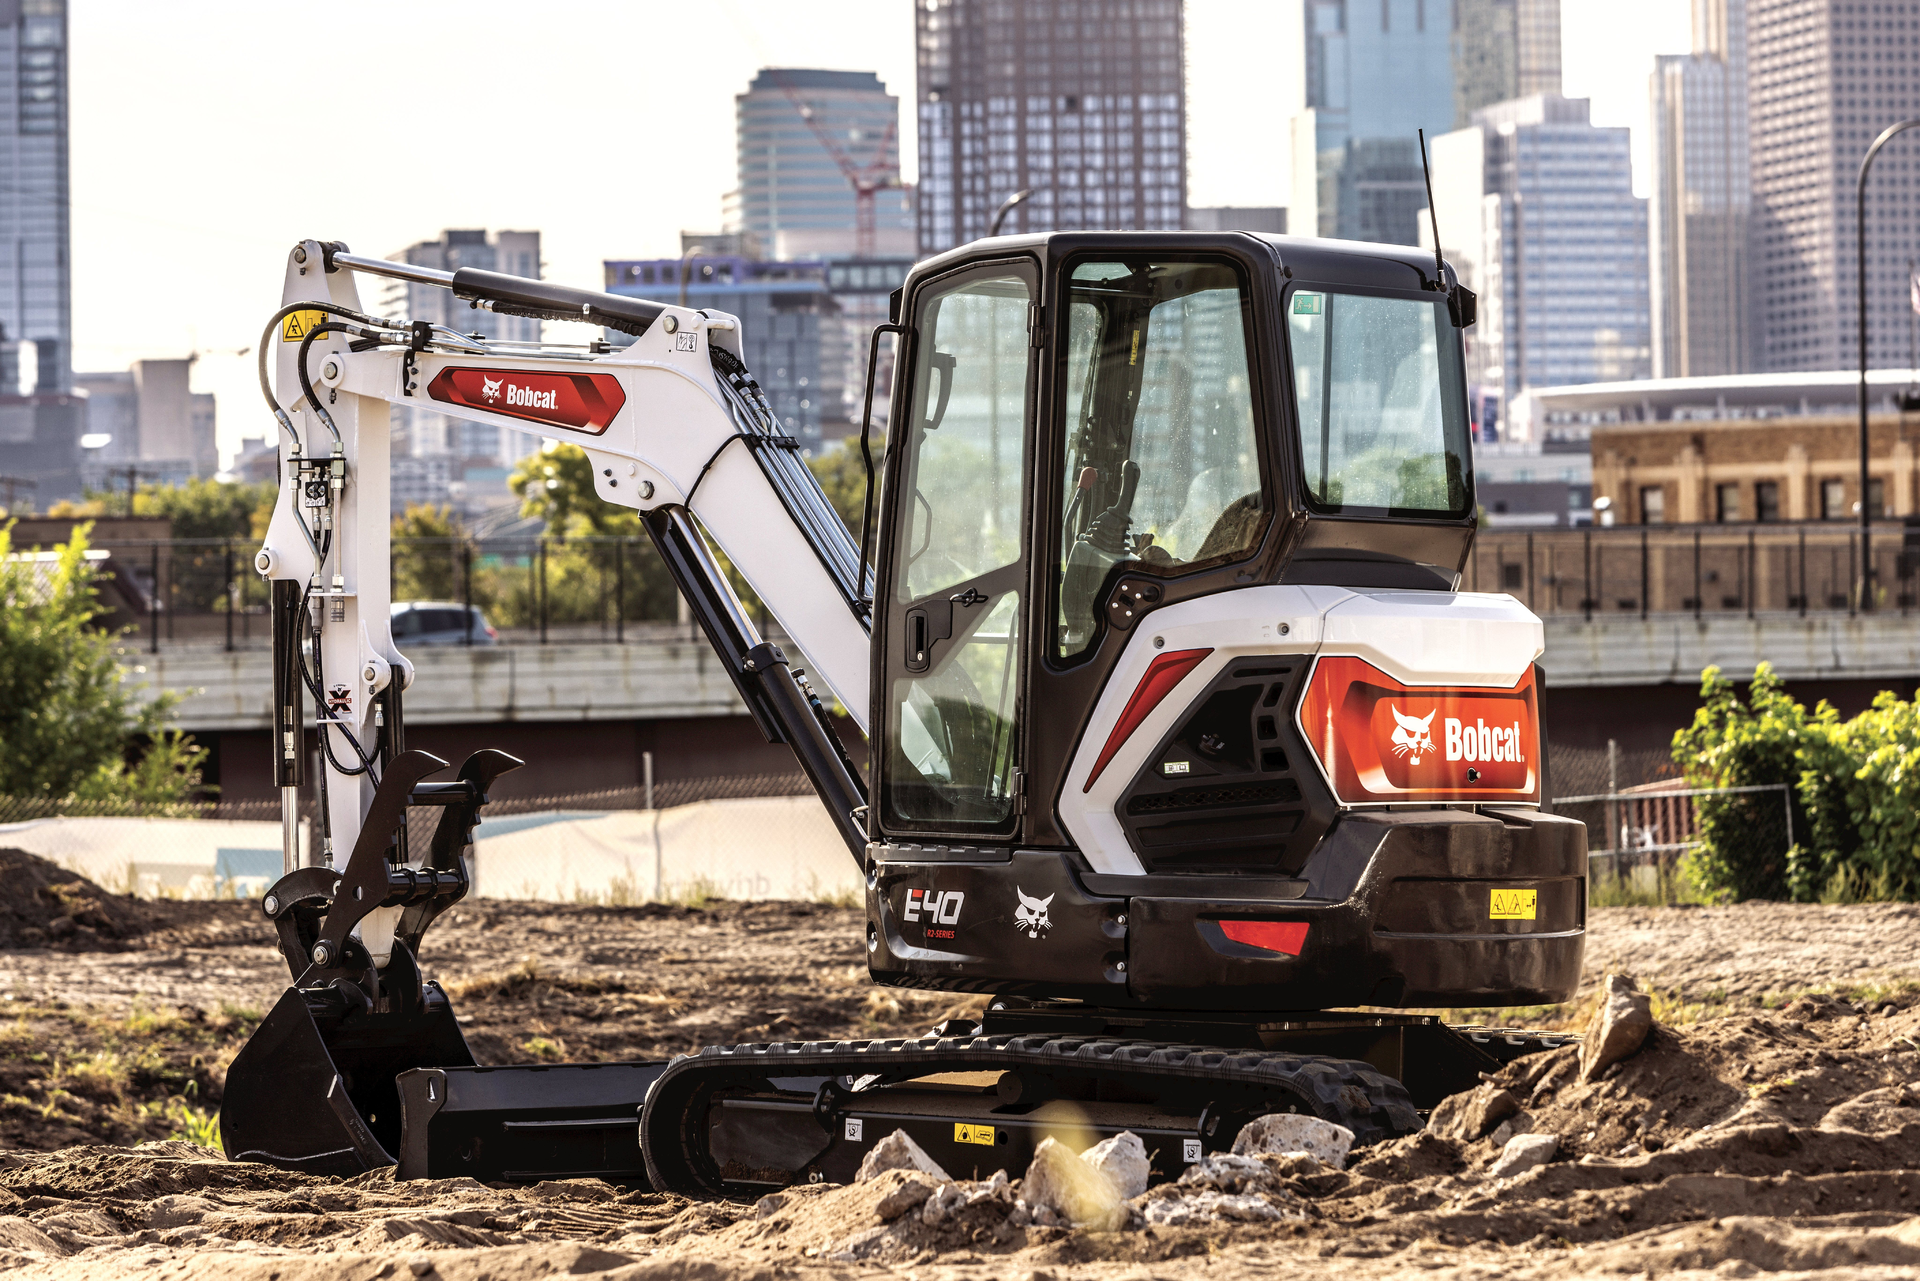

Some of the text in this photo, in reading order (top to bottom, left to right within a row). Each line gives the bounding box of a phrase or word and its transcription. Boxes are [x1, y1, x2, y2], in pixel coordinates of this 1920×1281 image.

[506, 384, 556, 409] Bobcat
[1445, 717, 1522, 763] Bobcat
[903, 888, 965, 925] E40
[926, 929, 955, 939] R2-SERIES
